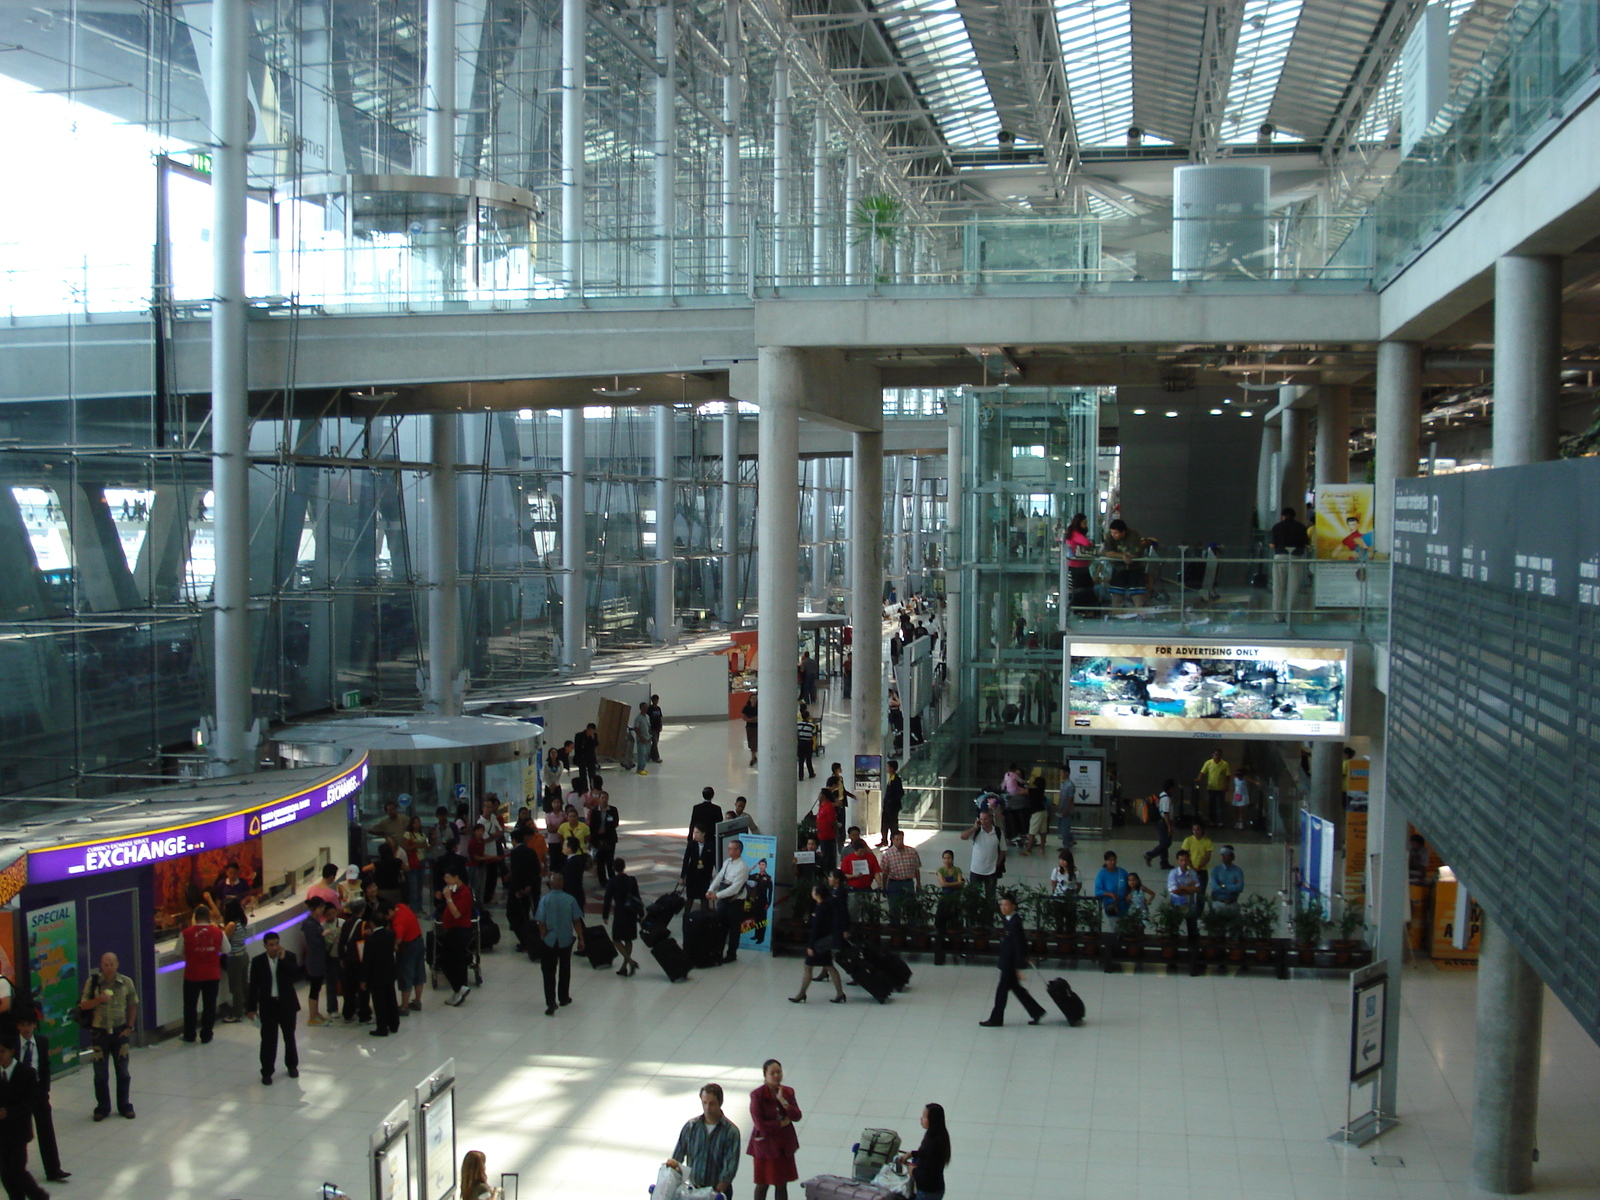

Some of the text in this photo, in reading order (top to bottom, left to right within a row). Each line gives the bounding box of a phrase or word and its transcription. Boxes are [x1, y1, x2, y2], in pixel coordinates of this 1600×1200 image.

[1432, 494, 1439, 535] B
[1155, 647, 1259, 656] FOR ADVERTISING ONLY
[459, 786, 468, 798] 2
[86, 836, 187, 871] EXCHANGE
[31, 906, 71, 928] SPECIAL
